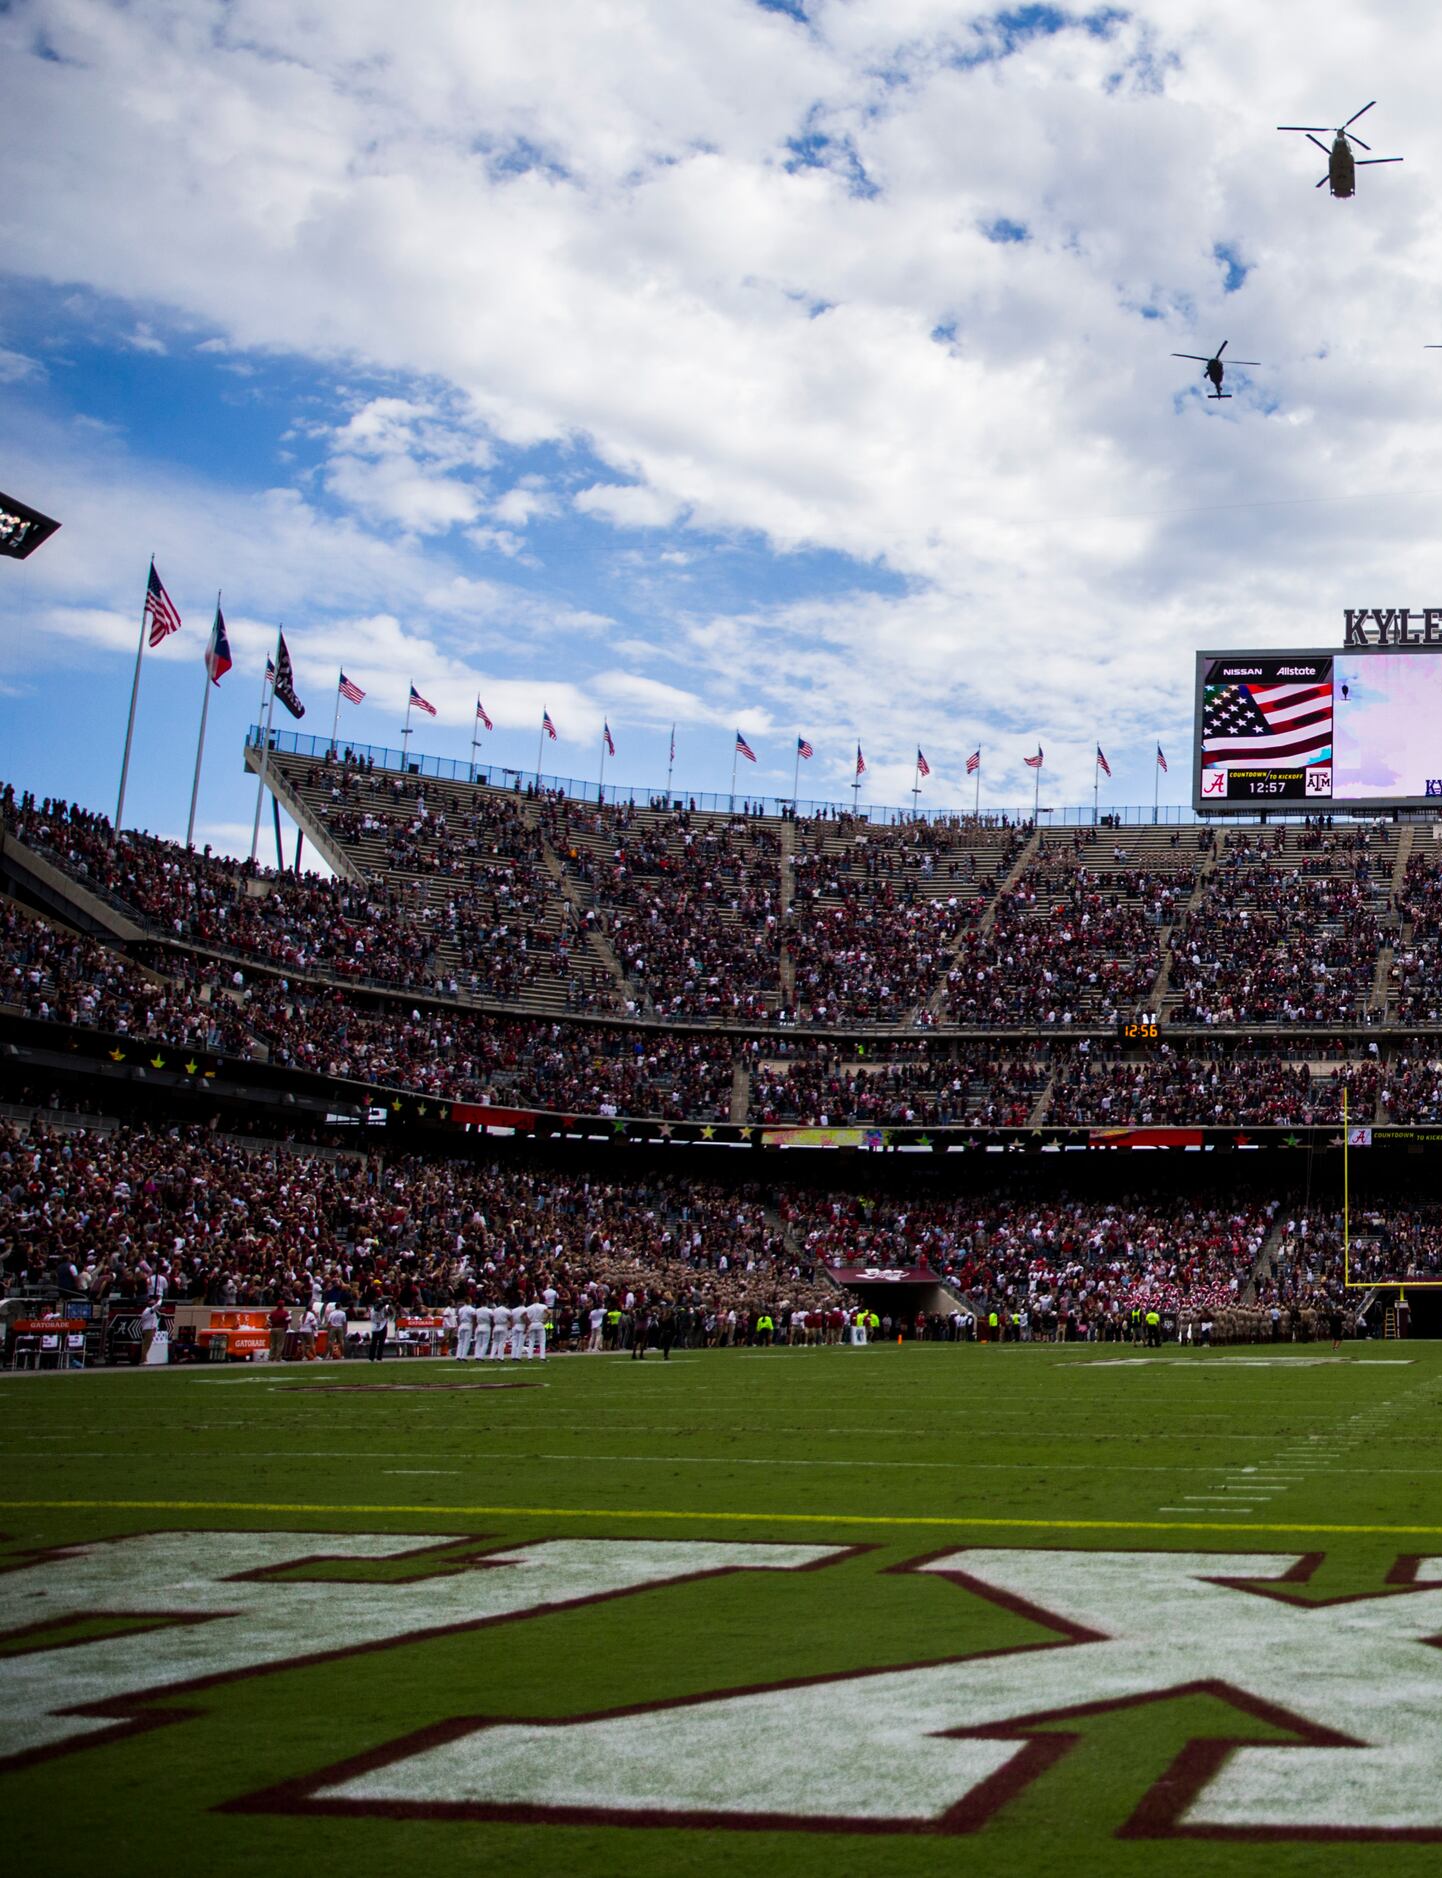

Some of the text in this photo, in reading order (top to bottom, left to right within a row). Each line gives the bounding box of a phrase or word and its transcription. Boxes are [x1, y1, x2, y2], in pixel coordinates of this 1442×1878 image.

[1223, 668, 1262, 676] NISSAN
[1276, 666, 1316, 676] Allstate
[1203, 773, 1224, 794] A
[1249, 782, 1286, 793] 12:57
[1125, 1024, 1158, 1037] 12:56
[30, 1321, 70, 1329] GATORADE
[234, 1339, 266, 1348] GATORADE
